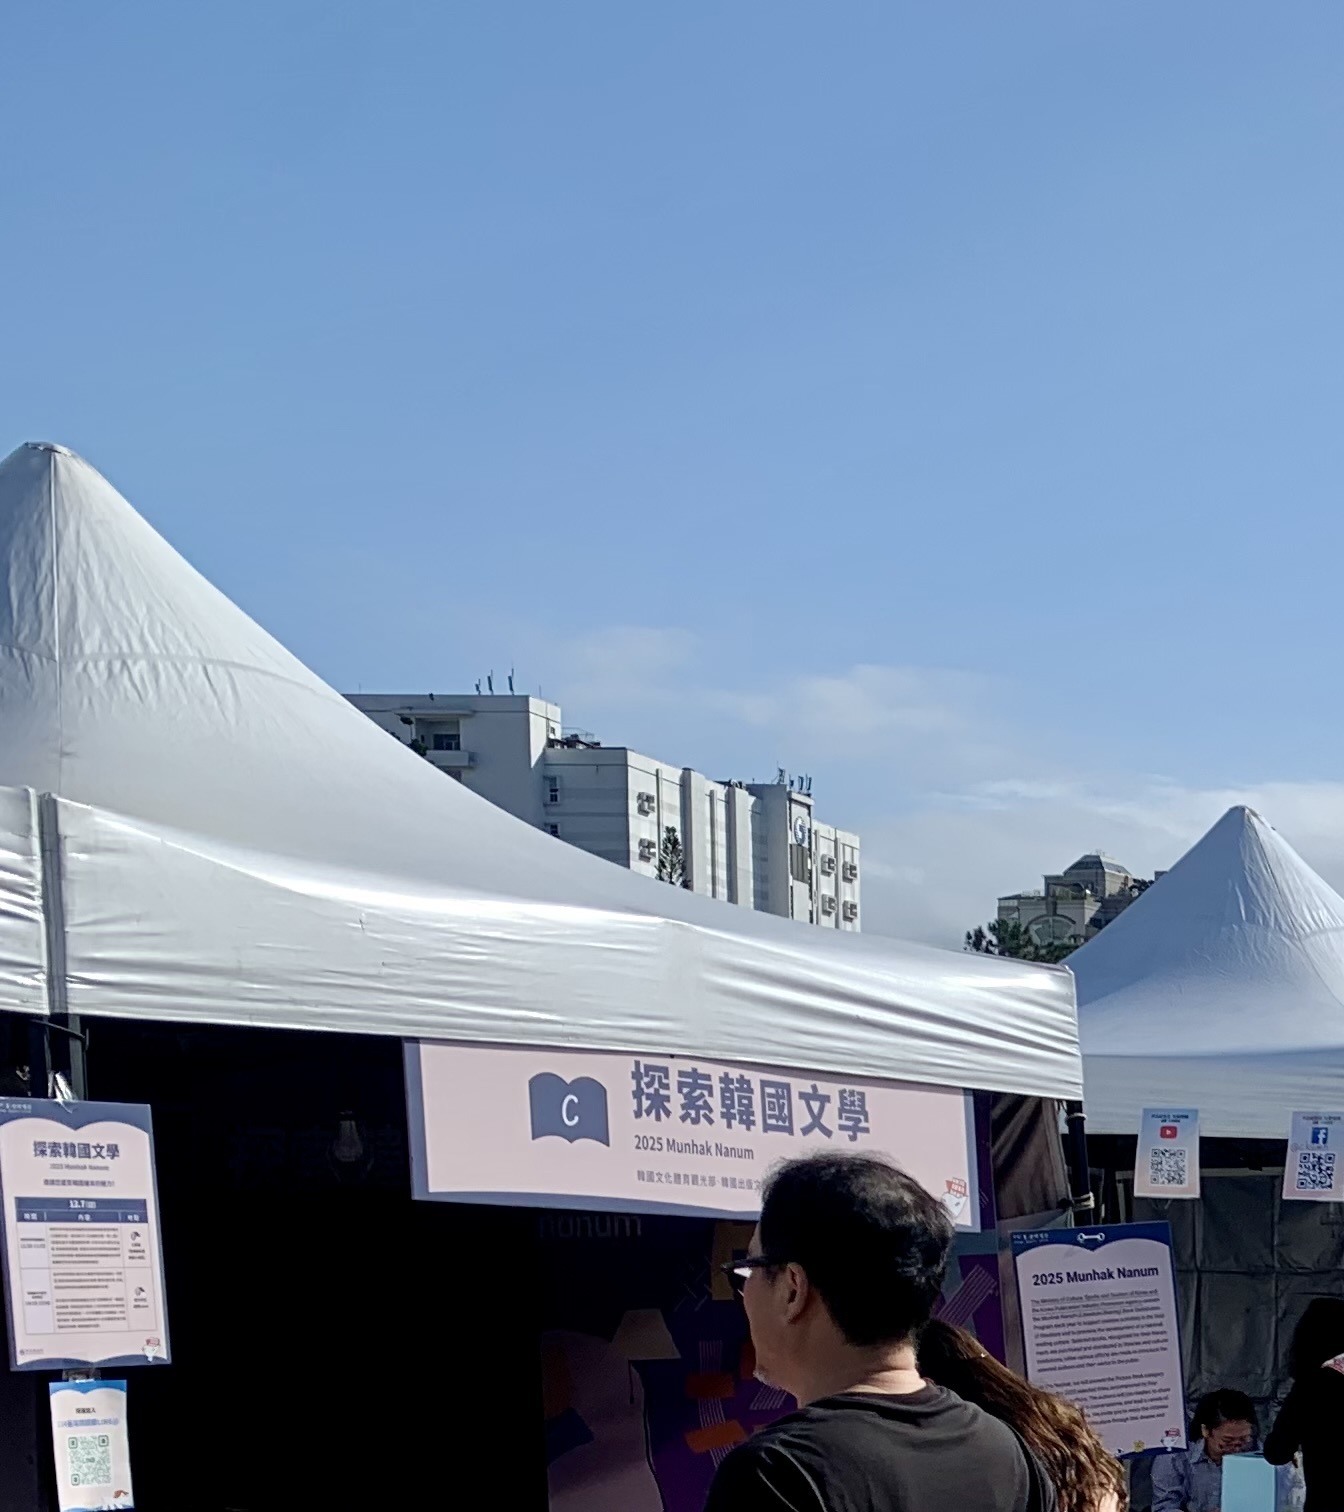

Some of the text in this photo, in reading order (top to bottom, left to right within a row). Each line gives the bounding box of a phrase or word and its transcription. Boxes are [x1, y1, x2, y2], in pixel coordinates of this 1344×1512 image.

[561, 1094, 579, 1127] C
[631, 1059, 871, 1143] 探索韓國文學
[33, 1140, 120, 1160] 探索韓國文學
[634, 1134, 755, 1161] 2025 Munhak Nanum
[1032, 1265, 1160, 1286] 2025 Munhak Nanum
